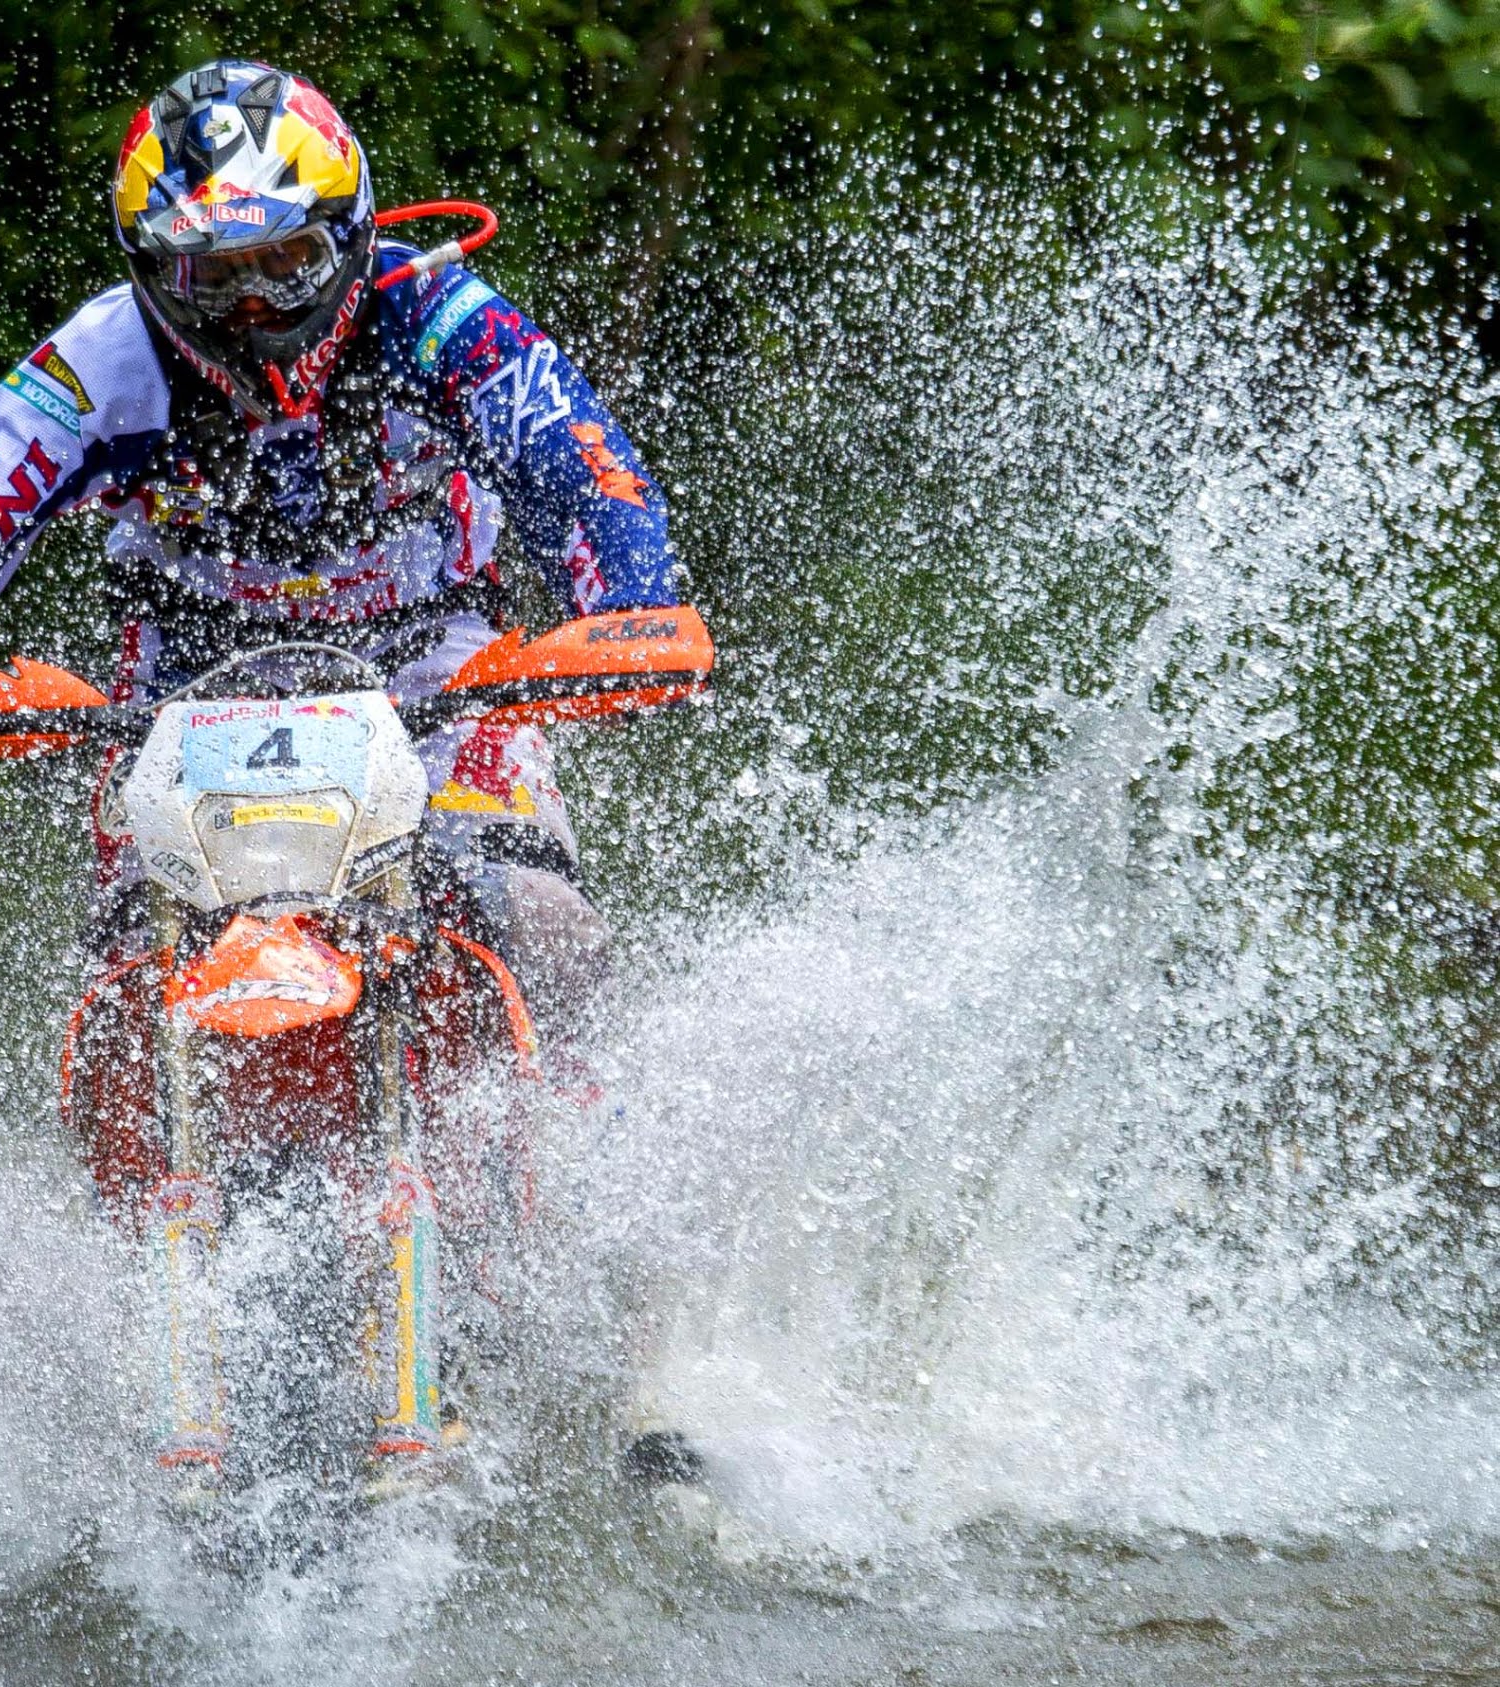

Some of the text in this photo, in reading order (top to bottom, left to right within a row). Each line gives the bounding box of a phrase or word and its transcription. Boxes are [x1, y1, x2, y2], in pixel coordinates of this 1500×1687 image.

[171, 202, 265, 236] Red Bull
[190, 708, 234, 729] Red
[246, 727, 301, 769] 4
